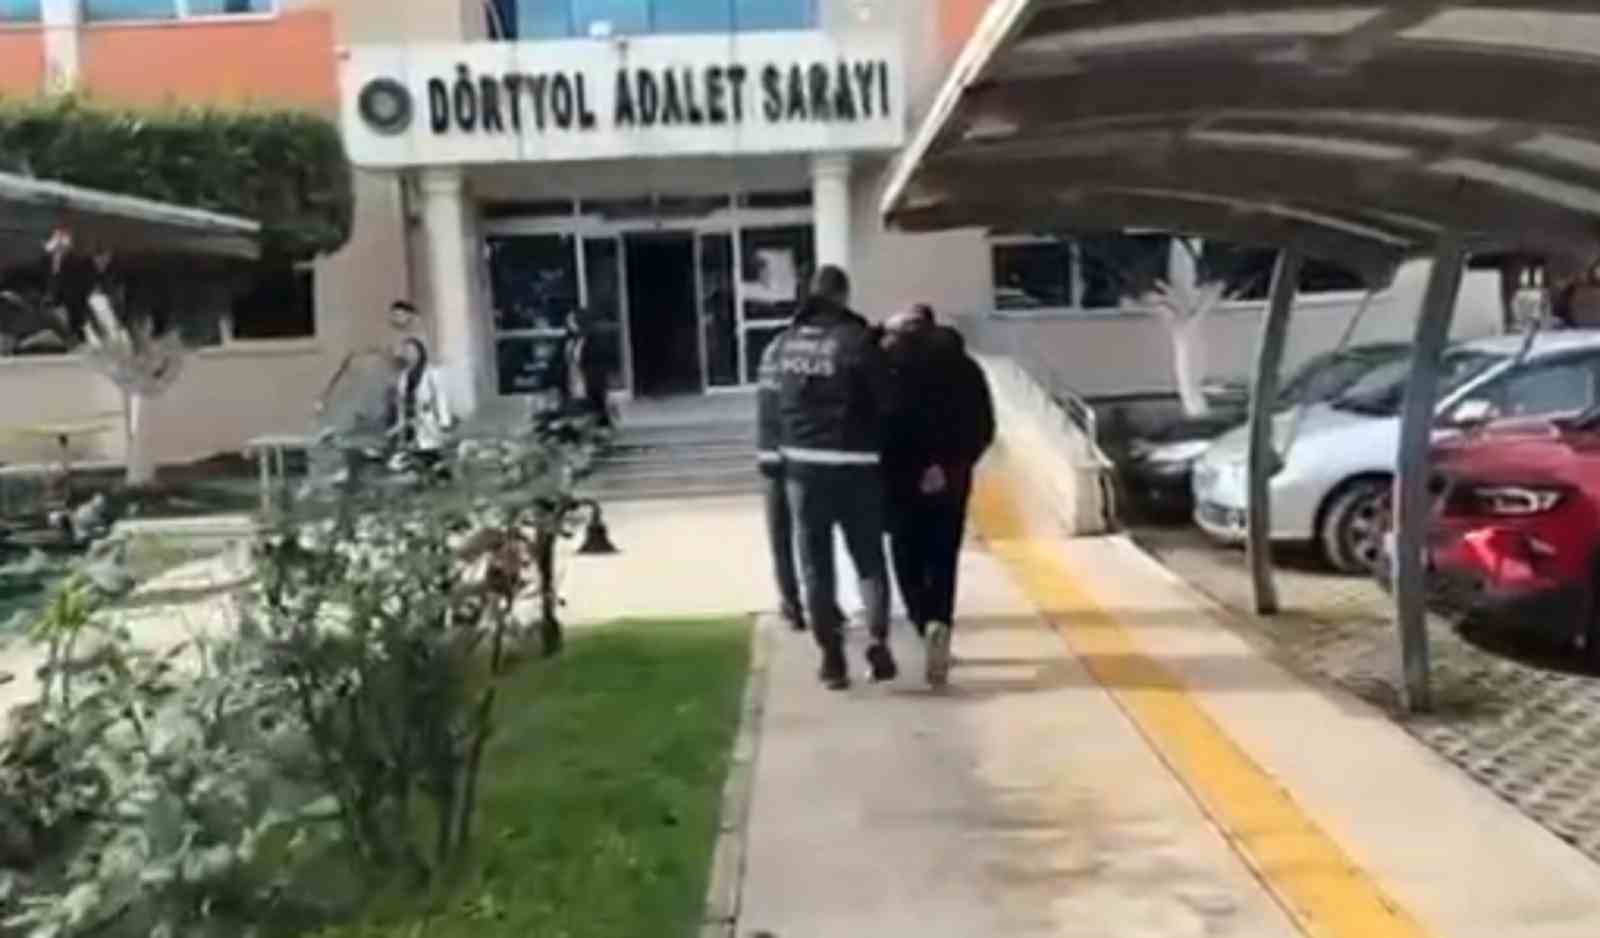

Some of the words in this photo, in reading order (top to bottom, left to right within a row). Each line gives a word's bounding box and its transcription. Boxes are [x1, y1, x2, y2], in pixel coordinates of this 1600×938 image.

[428, 62, 597, 134] DÖRTYOL
[614, 64, 748, 126] ADALET
[761, 60, 890, 122] SARAYI
